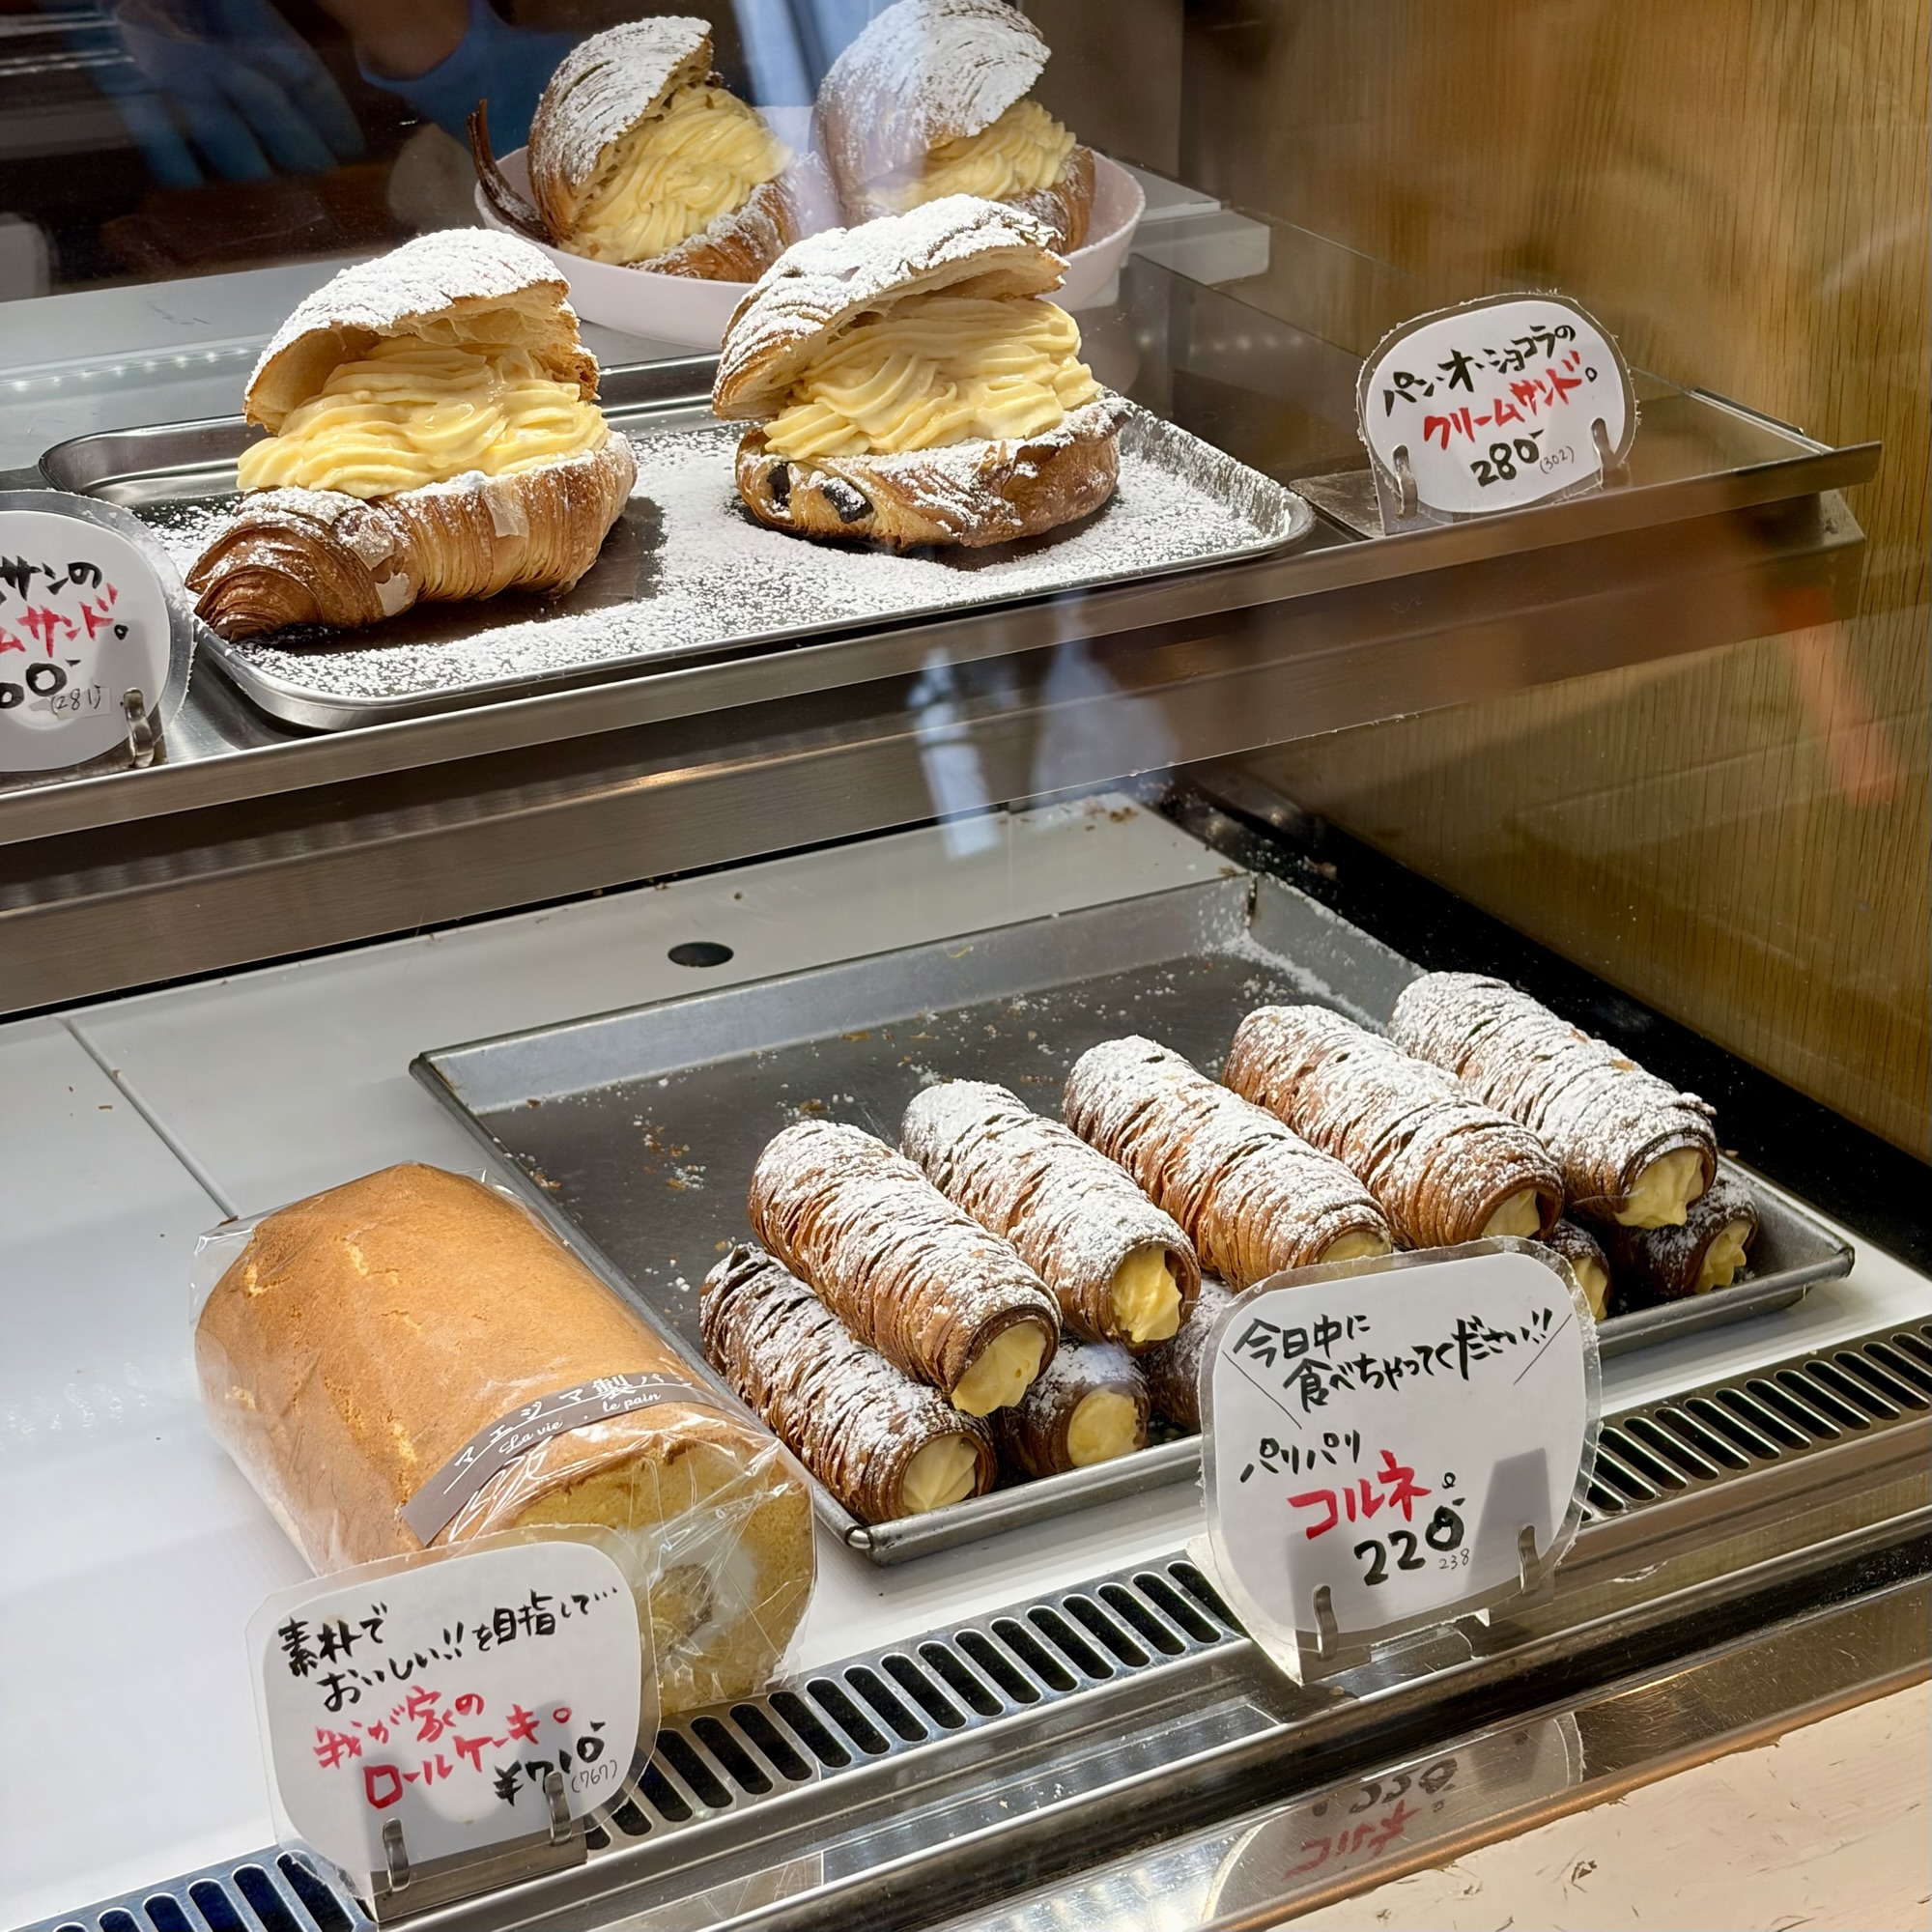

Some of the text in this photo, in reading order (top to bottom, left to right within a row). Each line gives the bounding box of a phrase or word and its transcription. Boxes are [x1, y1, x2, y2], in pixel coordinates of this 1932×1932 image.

[1540, 445, 1576, 474] (302)
[0, 555, 102, 602] サンの
[1232, 1314, 1372, 1368] 今日中に
[624, 1392, 662, 1411] pain
[1239, 1430, 1361, 1483] パリパリ
[1438, 1548, 1470, 1571] 238
[277, 1602, 388, 1677] 素朴で
[313, 1685, 486, 1770] 我が家の
